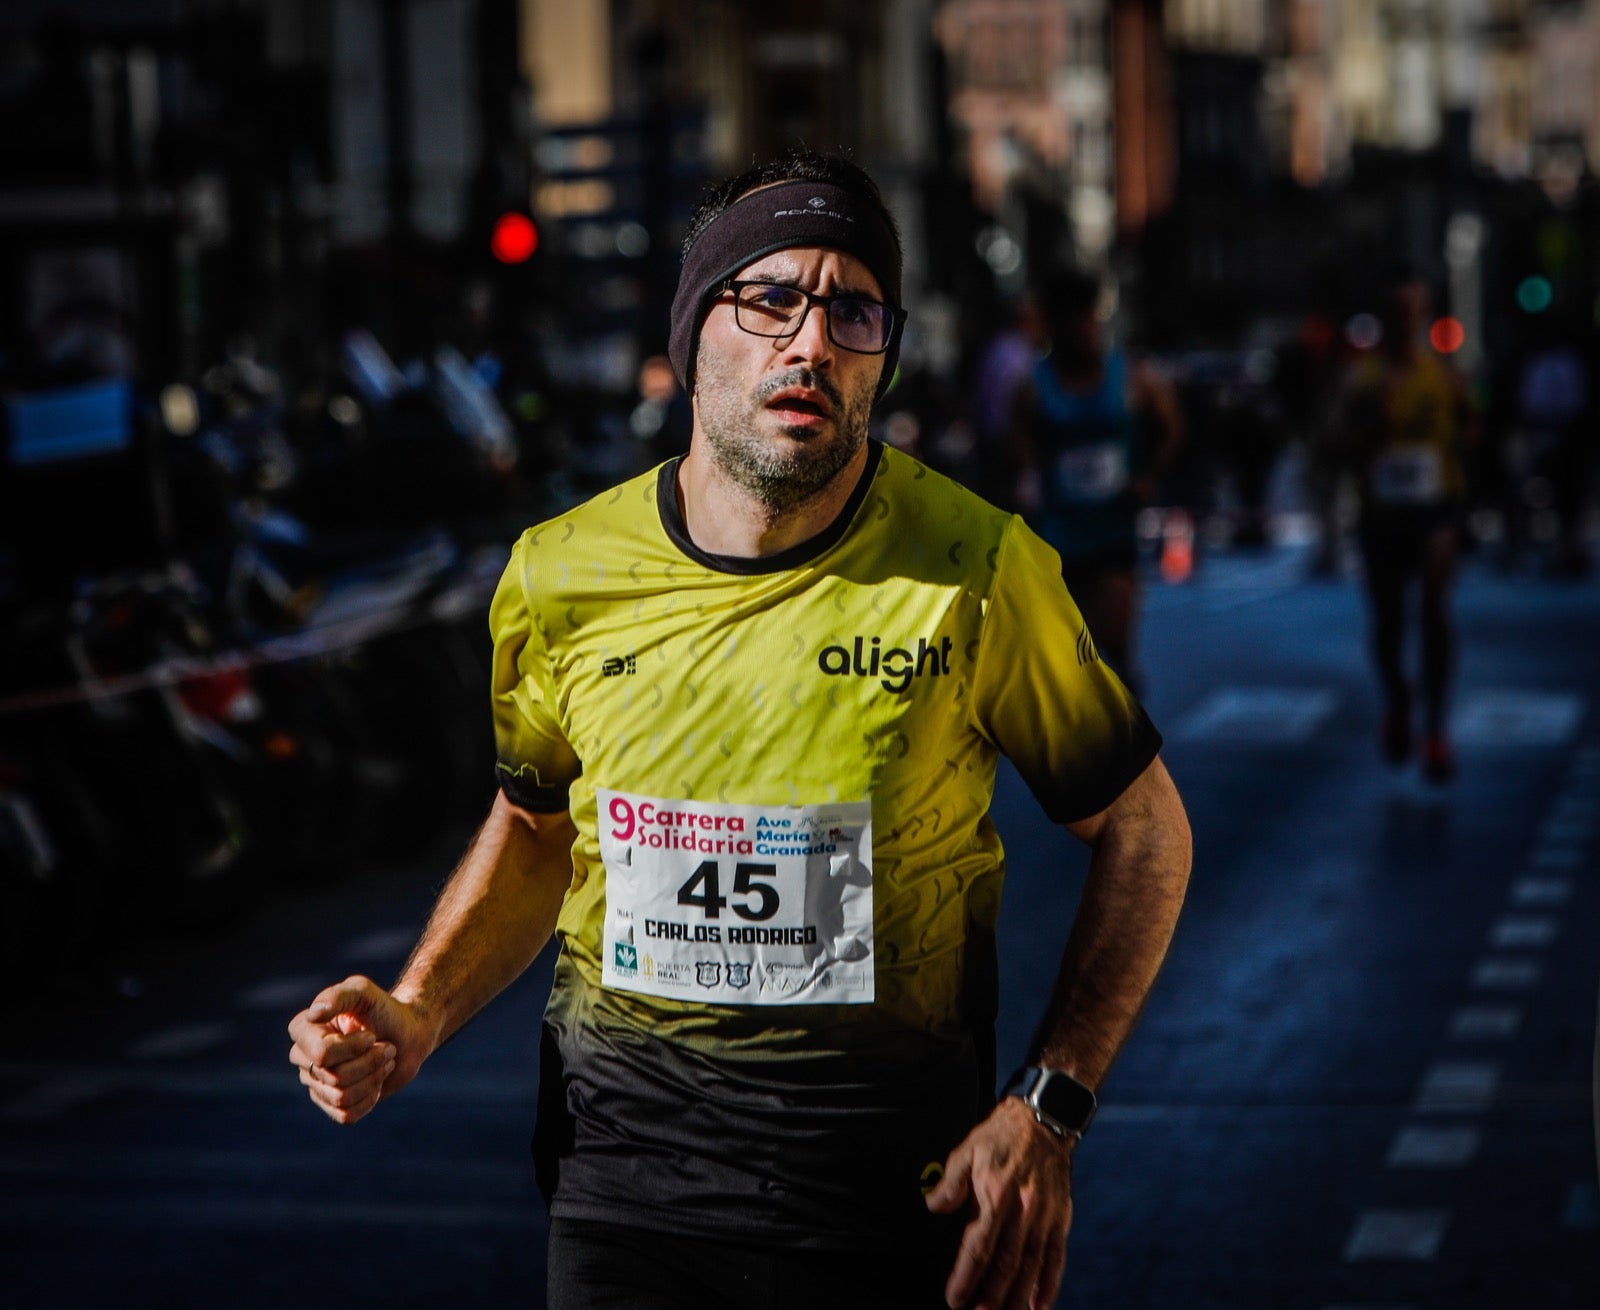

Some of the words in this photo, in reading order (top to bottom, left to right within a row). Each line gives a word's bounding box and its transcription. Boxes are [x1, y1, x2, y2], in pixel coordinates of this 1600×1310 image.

[818, 636, 952, 694] alight
[608, 797, 636, 841] 9
[638, 802, 745, 832] Carrera
[756, 816, 791, 828] Ave
[638, 825, 753, 855] Solidaria
[756, 829, 810, 842] María
[756, 842, 837, 855] Granada
[677, 860, 780, 922] 45
[645, 918, 721, 944] CARLOS
[728, 925, 817, 945] RODRIGO
[657, 970, 680, 980] REAL
